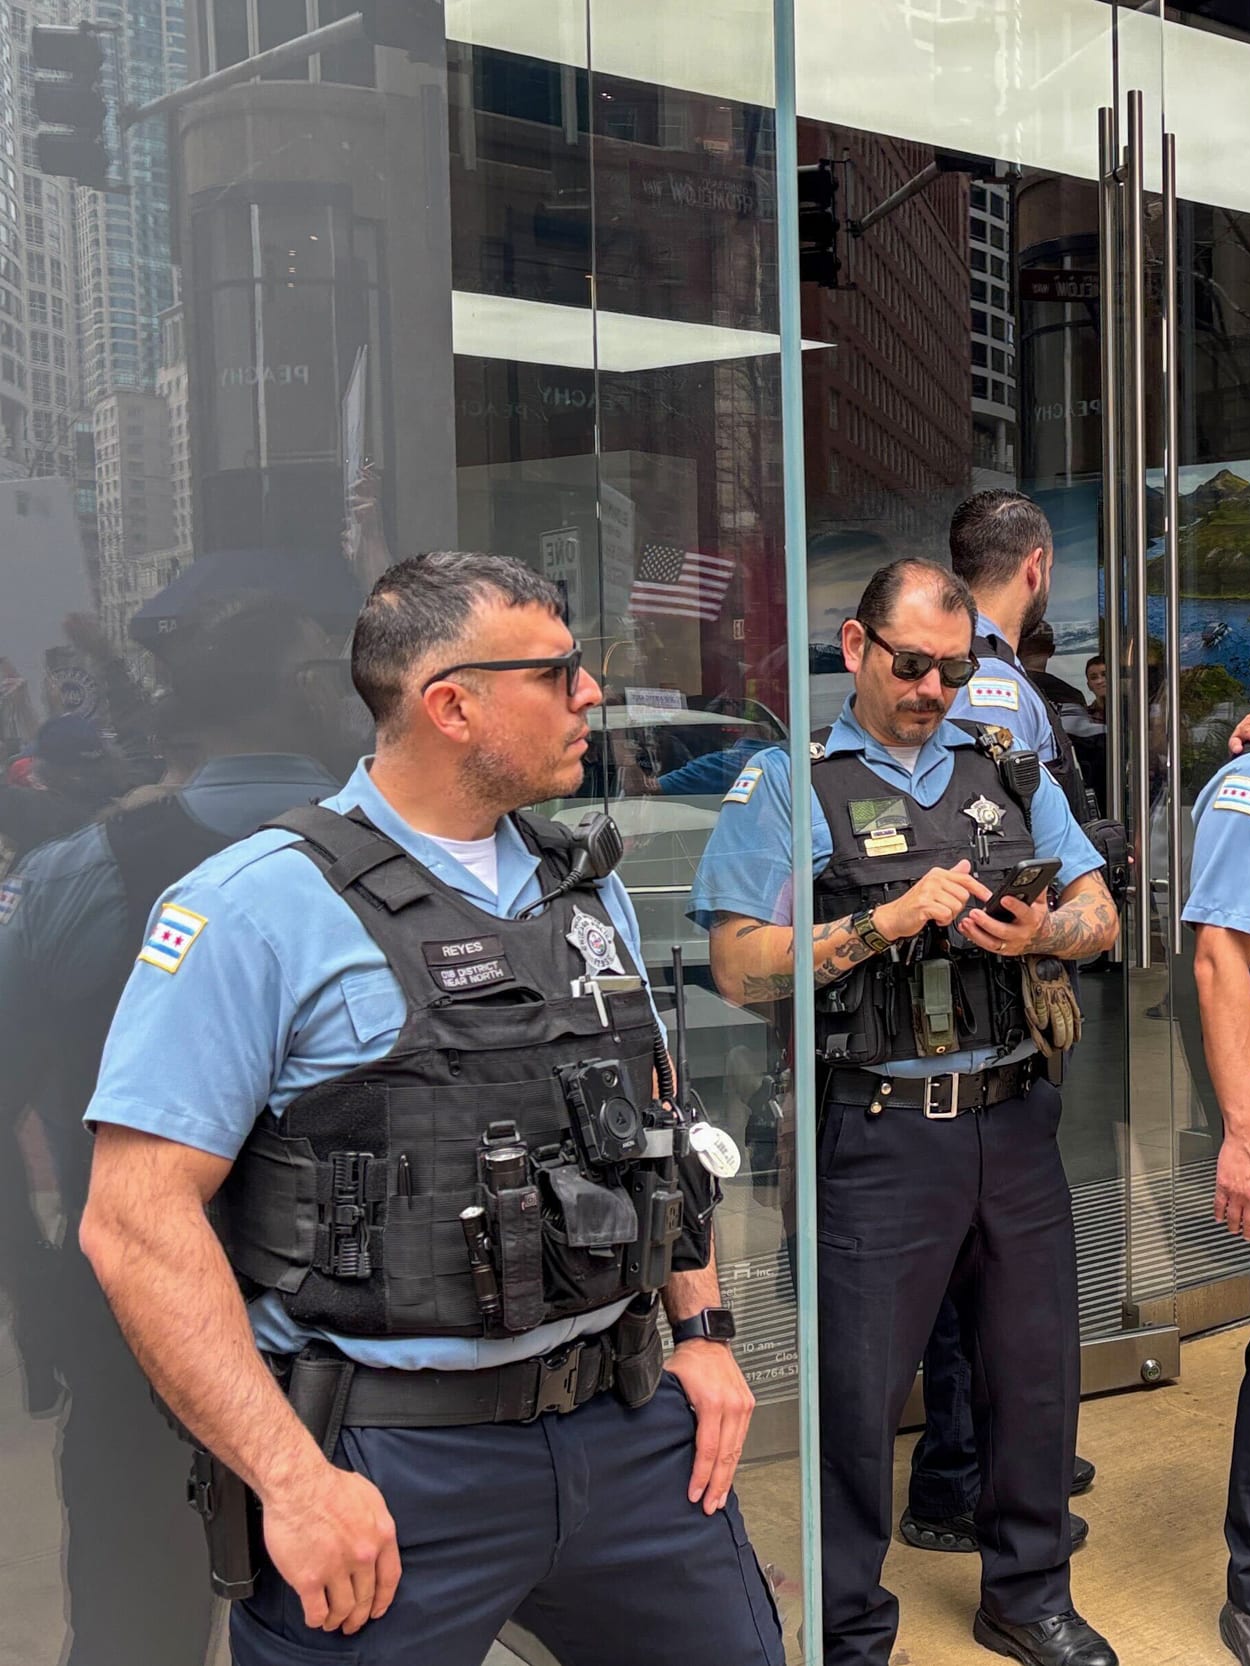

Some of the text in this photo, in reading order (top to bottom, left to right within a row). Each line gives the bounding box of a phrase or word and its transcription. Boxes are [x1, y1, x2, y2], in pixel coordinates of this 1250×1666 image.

[441, 941, 483, 957] REYES
[456, 960, 498, 977] DISTRICT
[442, 968, 504, 987] NEAR NORTH
[742, 1343, 755, 1353] 10
[757, 1341, 775, 1351] am
[775, 1351, 798, 1362] Clos
[745, 1364, 799, 1382] 312.764.51
